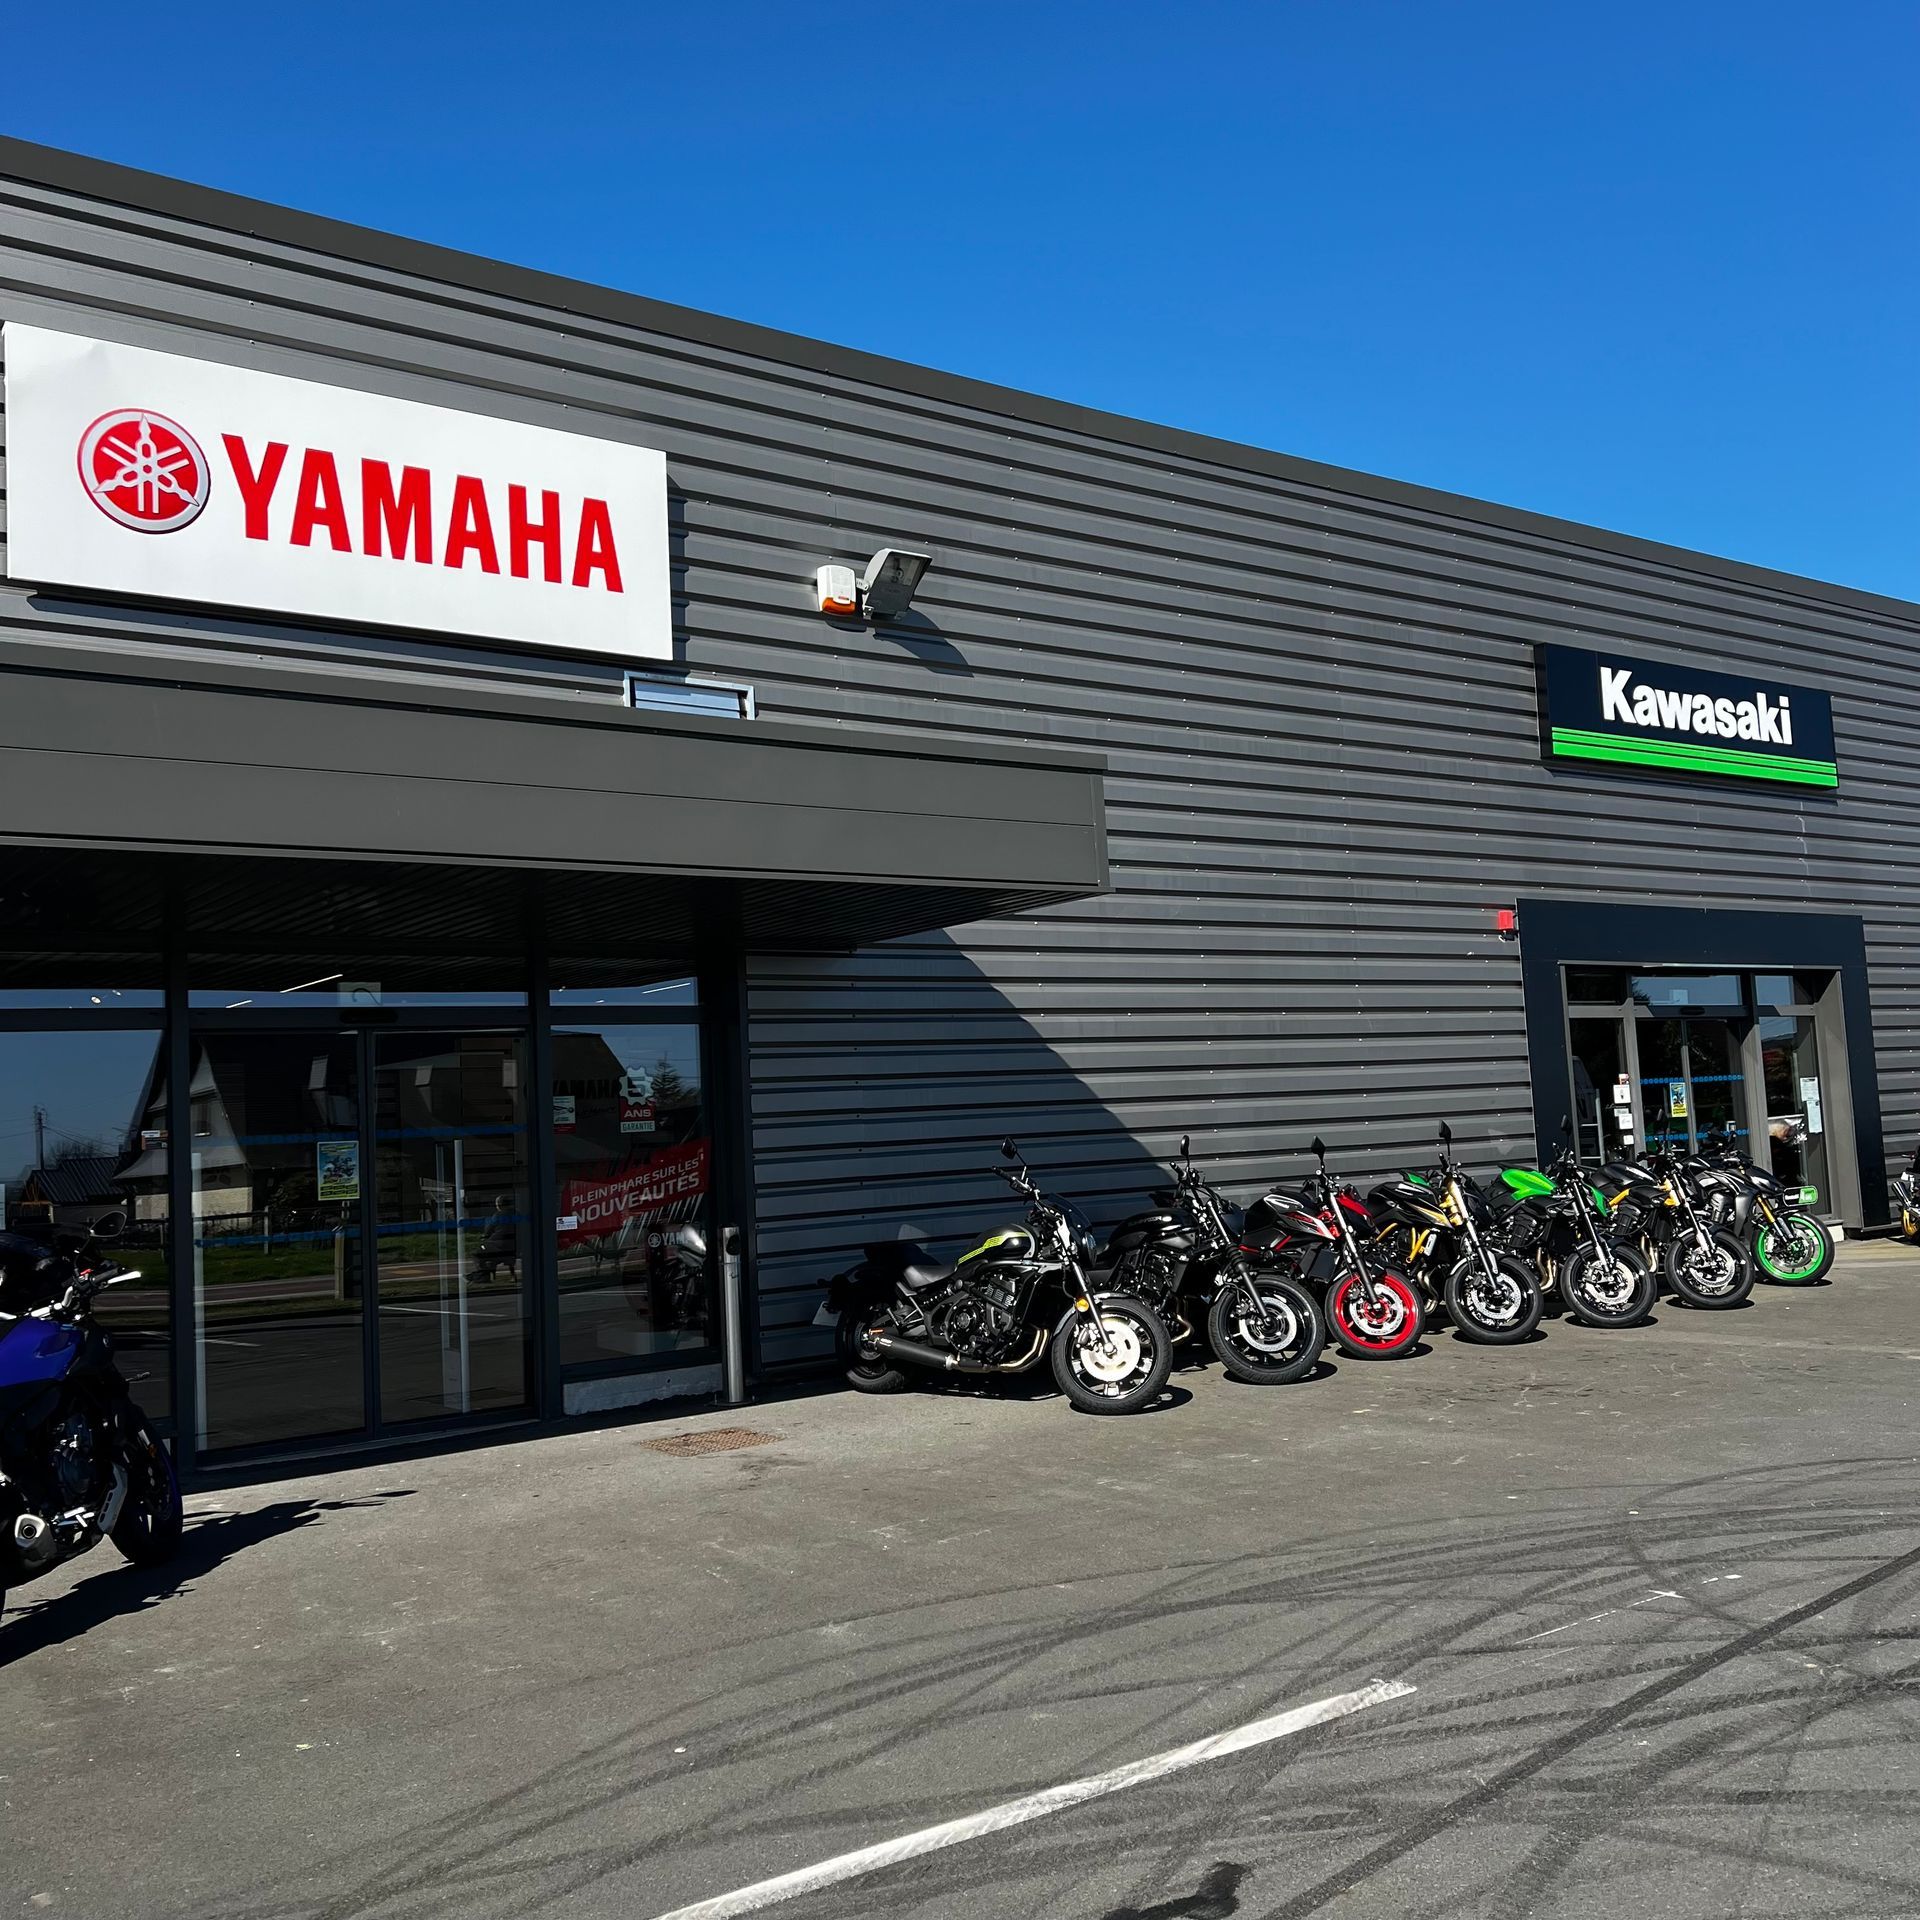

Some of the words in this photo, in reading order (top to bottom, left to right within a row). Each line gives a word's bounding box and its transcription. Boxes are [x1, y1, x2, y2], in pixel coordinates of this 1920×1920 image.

[221, 433, 624, 593] YAMAHA
[1600, 666, 1793, 745] Kawasaki
[627, 1076, 648, 1098] 5
[622, 1121, 654, 1132] GARANTIE
[624, 1109, 652, 1119] ANS
[571, 1186, 608, 1207] PLEIN
[610, 1173, 650, 1194] PHARE
[651, 1164, 677, 1181] SUR
[677, 1156, 700, 1174] LES
[572, 1171, 700, 1224] NOUVEAUTÉS
[662, 1229, 708, 1246] YAMA
